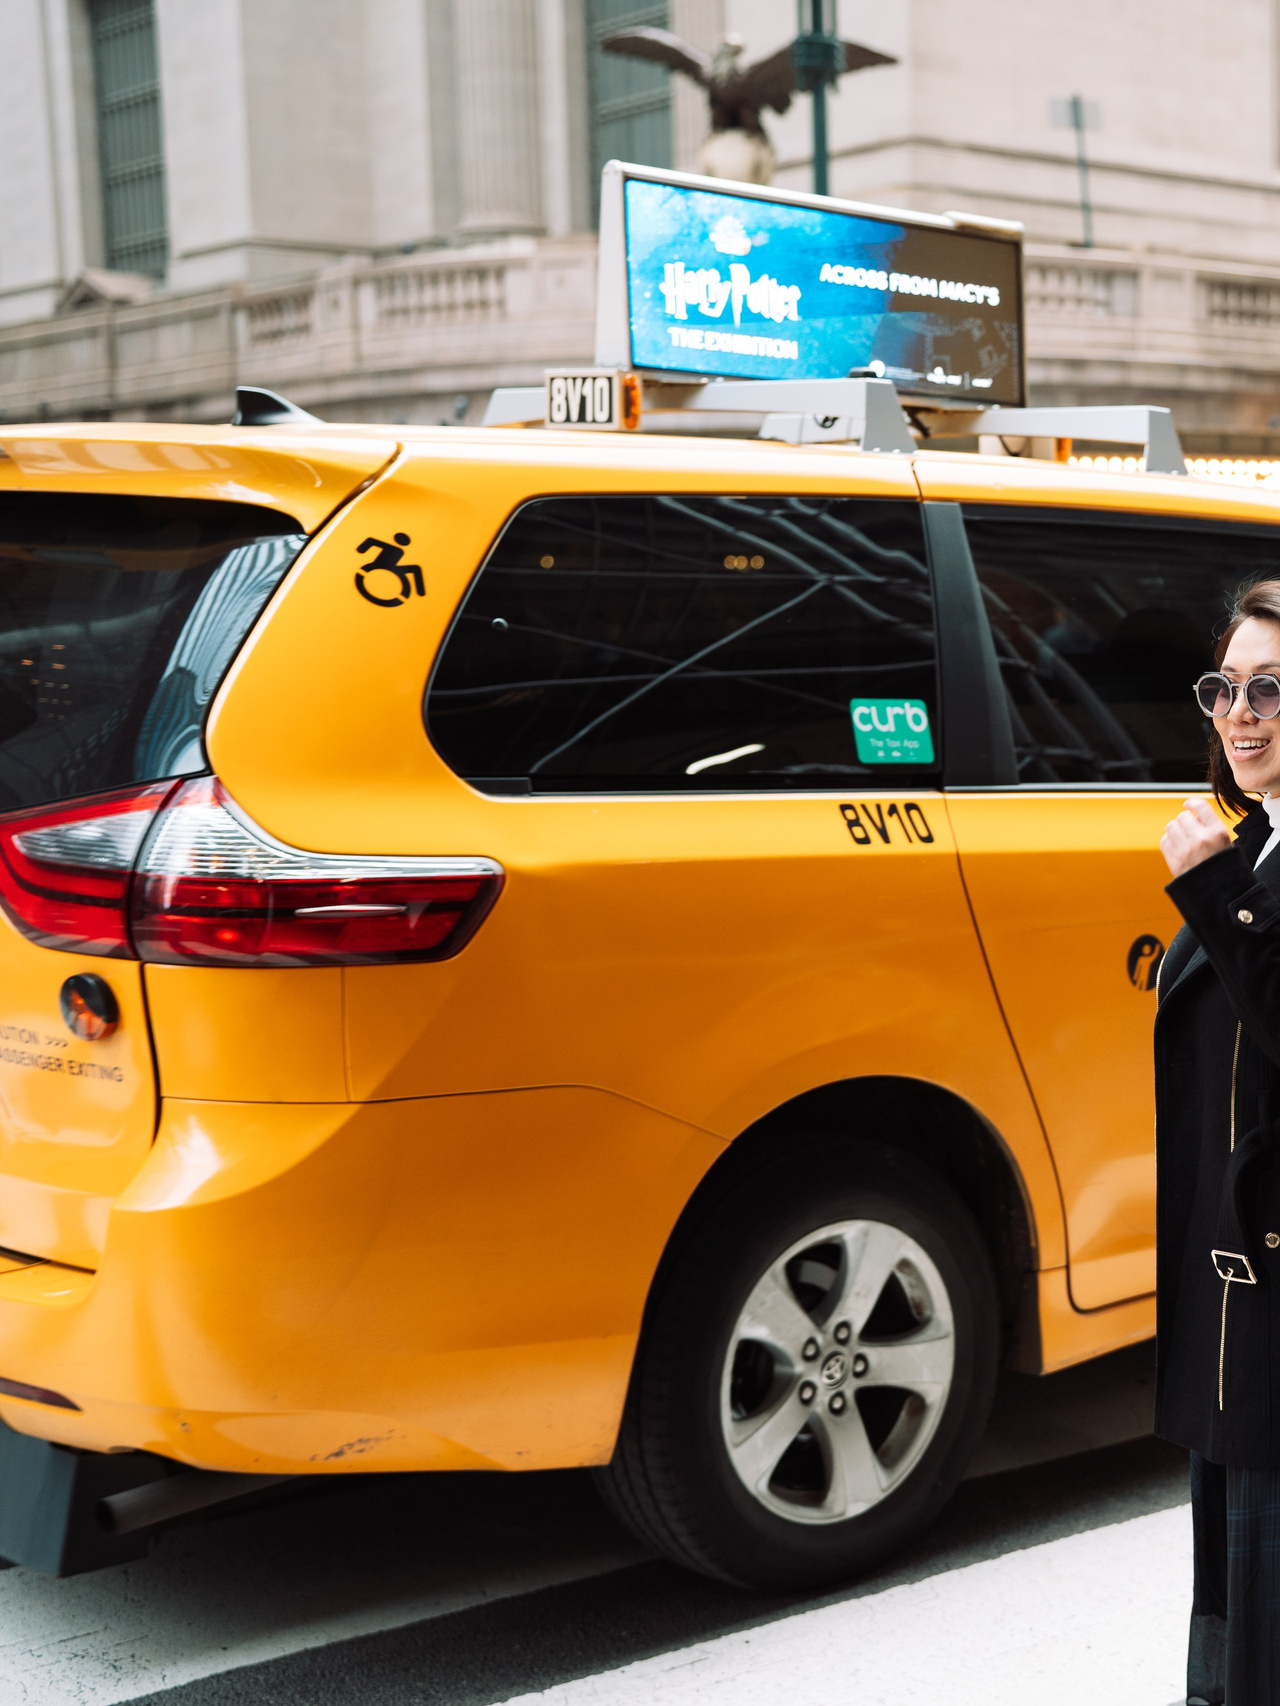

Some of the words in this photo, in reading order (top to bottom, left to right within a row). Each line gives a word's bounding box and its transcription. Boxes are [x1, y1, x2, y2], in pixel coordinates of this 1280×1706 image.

[658, 261, 733, 320] Harry
[729, 263, 803, 329] Potter
[819, 263, 888, 291] ACROSS
[888, 272, 938, 298] FROM
[938, 280, 1001, 307] MACY'S
[667, 327, 704, 350] THE
[704, 331, 798, 360] EXHIBITION
[551, 377, 610, 422] 8V10
[852, 702, 929, 733] curb
[869, 738, 885, 748] The
[886, 738, 902, 748] Taxi
[903, 739, 920, 749] App
[839, 802, 935, 845] 8V10
[67, 1059, 125, 1083] EXITING
